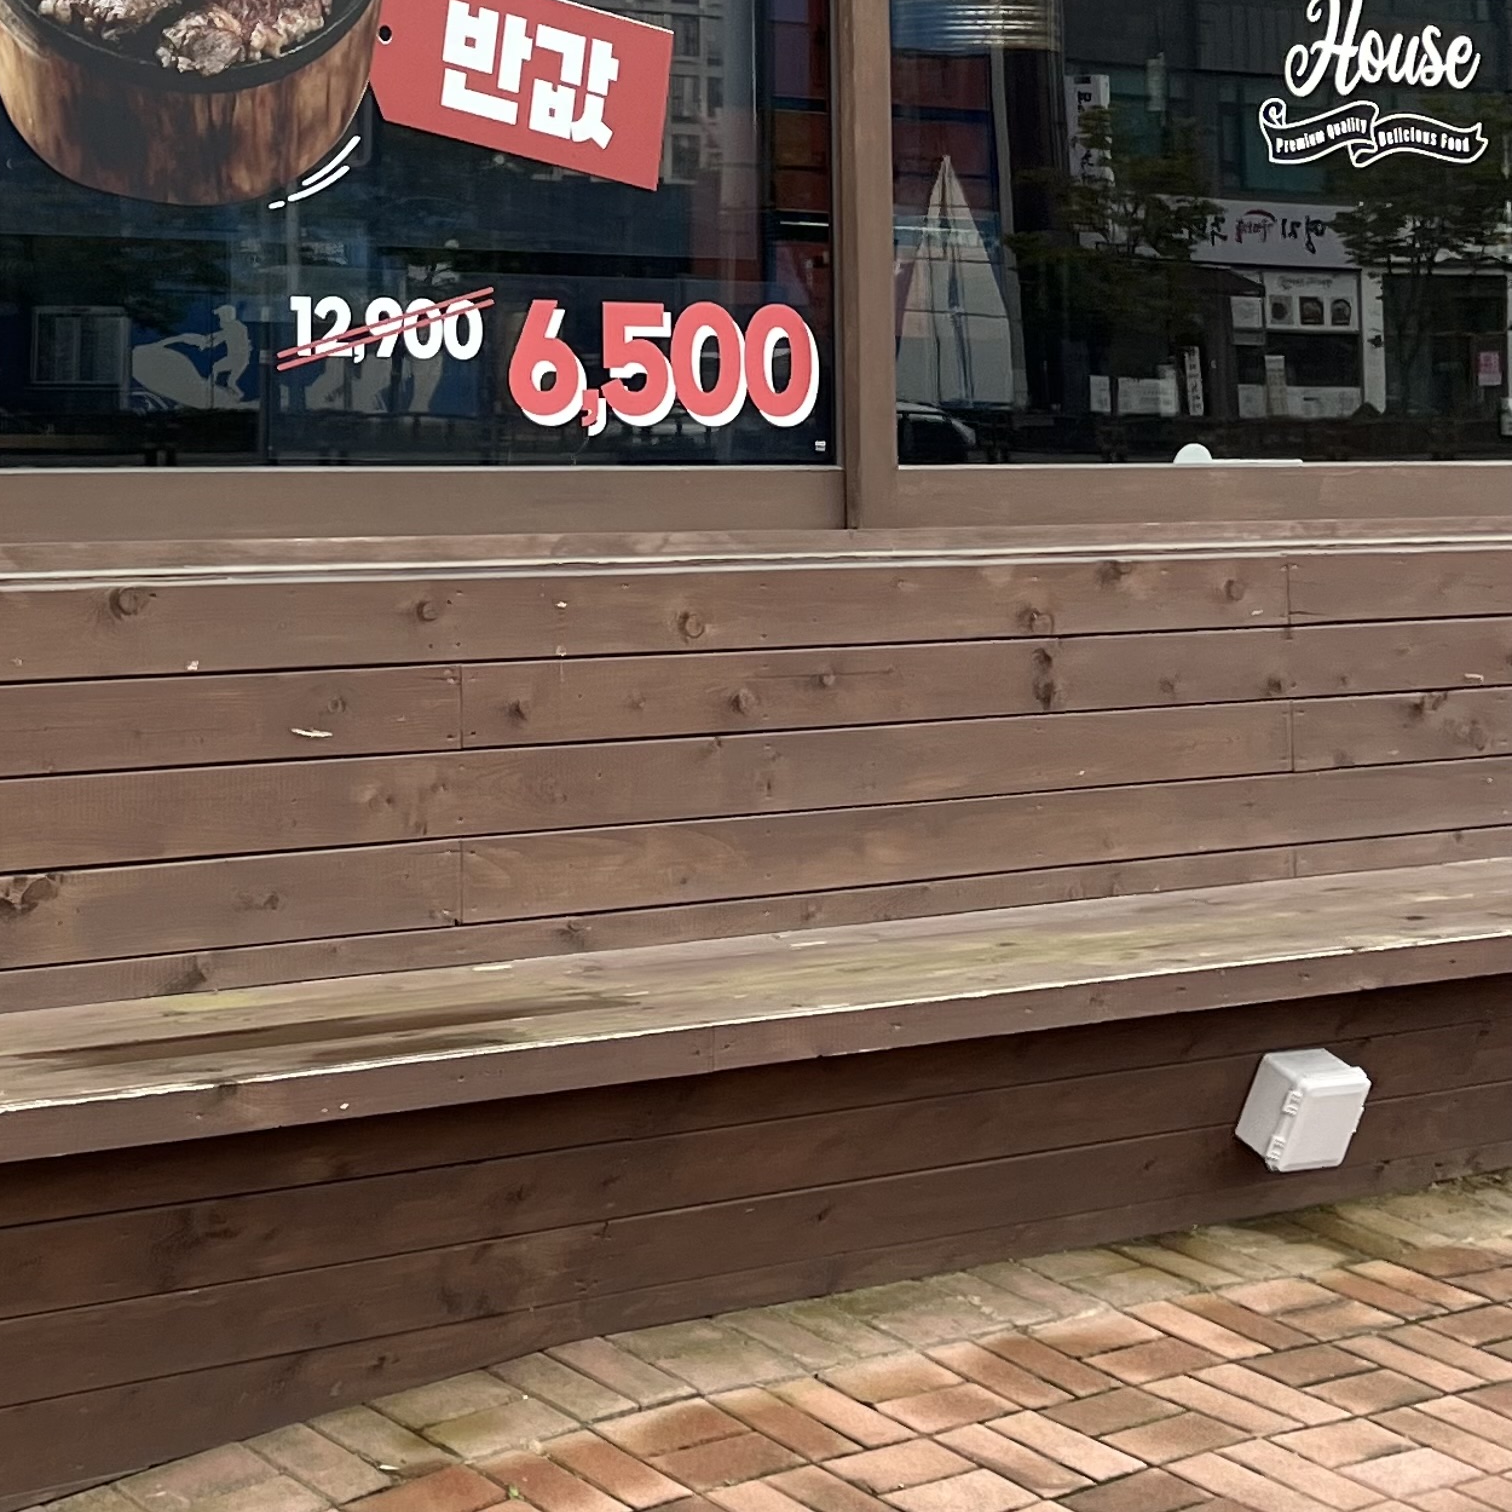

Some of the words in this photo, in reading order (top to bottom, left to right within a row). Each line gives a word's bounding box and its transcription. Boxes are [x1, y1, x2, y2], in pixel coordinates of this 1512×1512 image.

[1275, 130, 1326, 153] Premium
[1326, 117, 1367, 140] Quality
[1377, 126, 1437, 147] Delicious
[1440, 133, 1471, 153] Food
[289, 295, 484, 364] 12,900
[508, 299, 820, 436] 6,500
